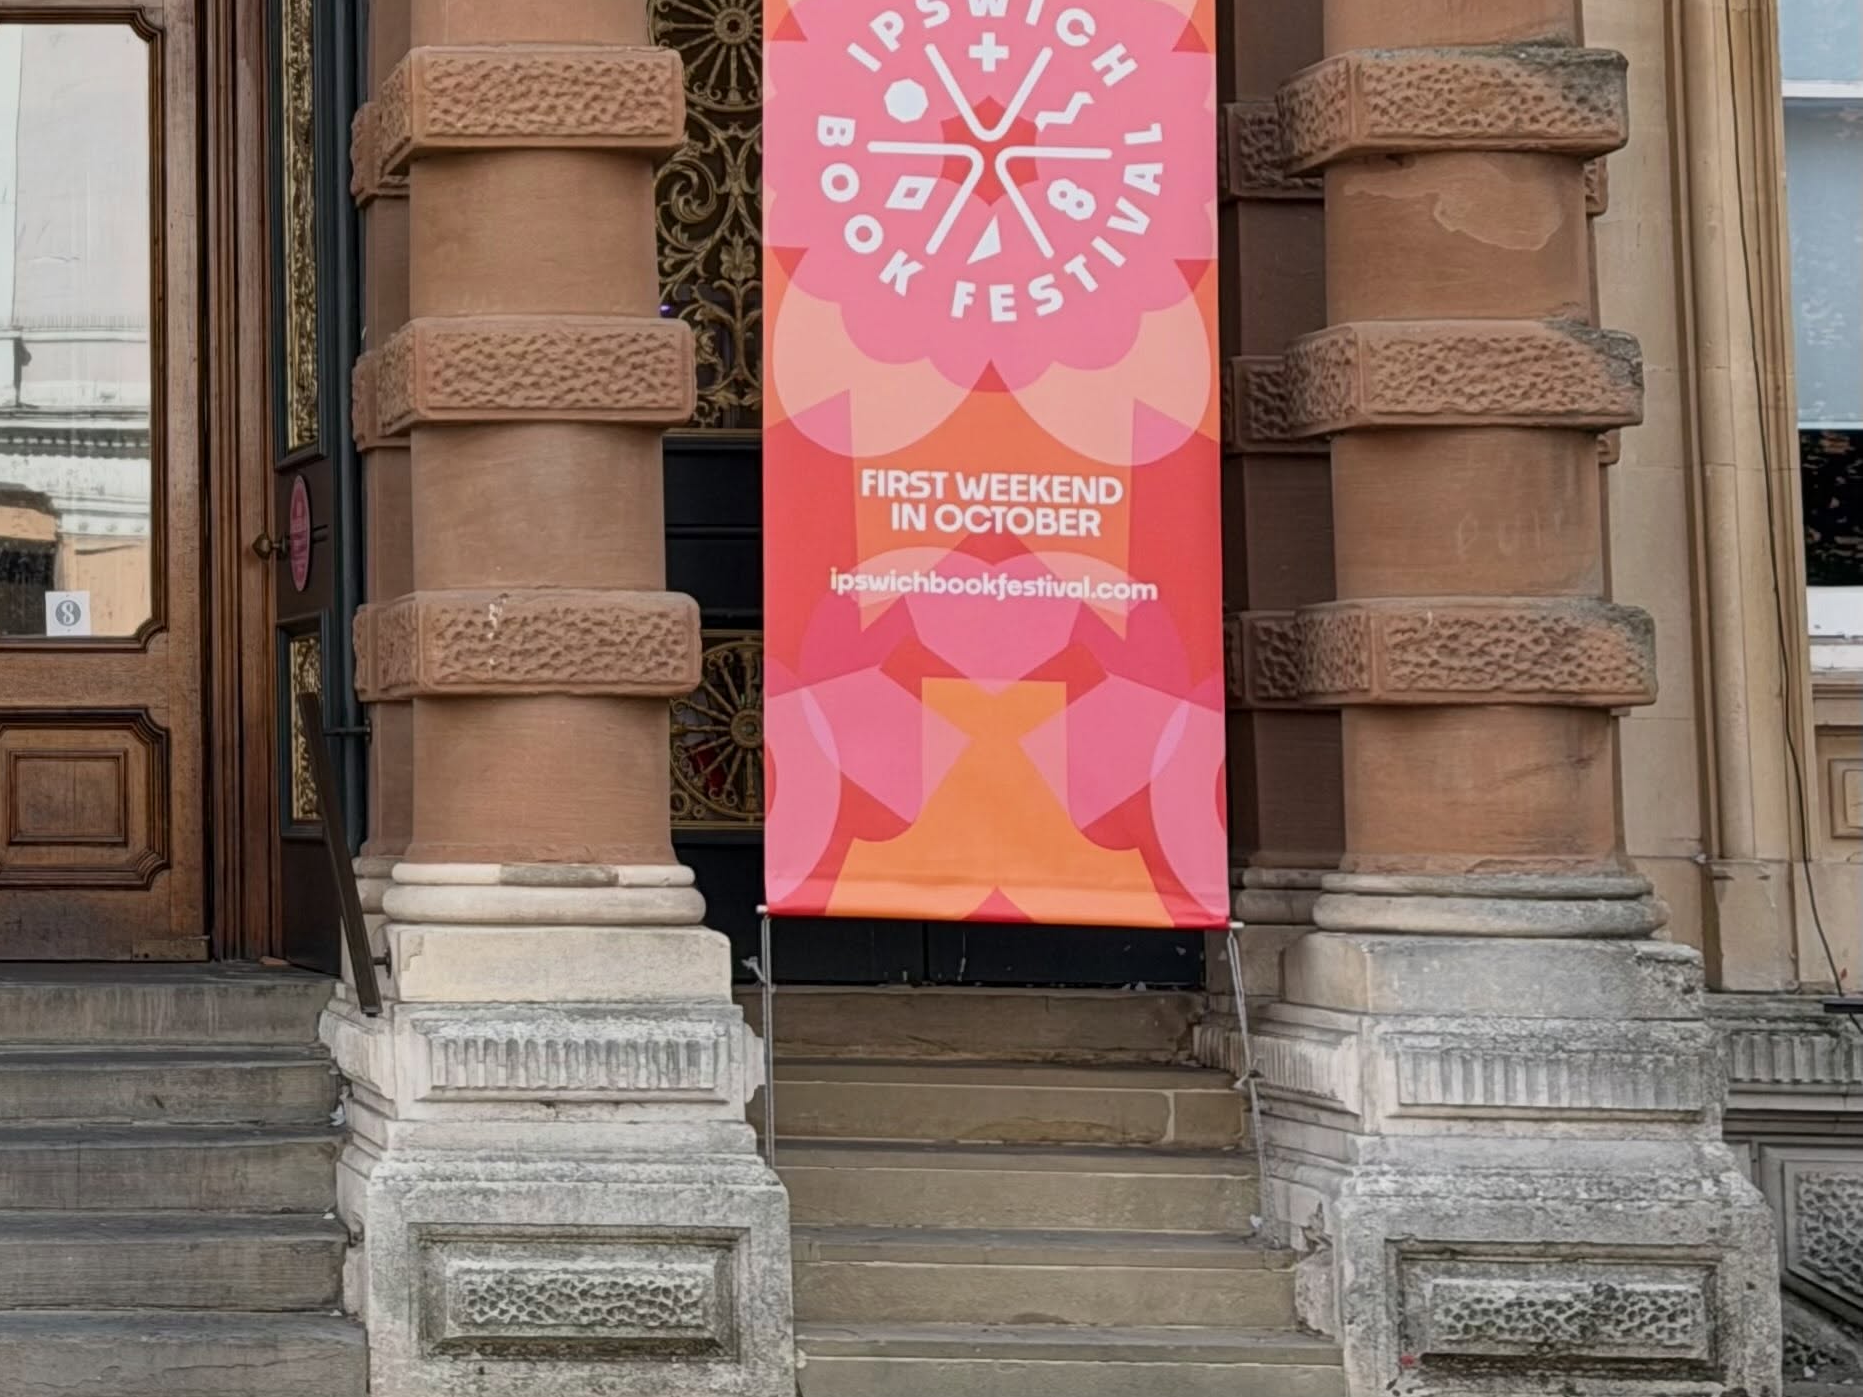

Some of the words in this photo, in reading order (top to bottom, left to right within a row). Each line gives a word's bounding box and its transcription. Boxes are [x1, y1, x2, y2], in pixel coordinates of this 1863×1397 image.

[817, 115, 924, 296] BOOK
[950, 122, 1164, 322] FESTIVAL
[861, 469, 949, 499] FIRST
[957, 472, 1124, 505] WEEKEND
[890, 502, 926, 532] IN
[934, 504, 1102, 537] OCTOBER
[830, 567, 1158, 601] ipswichbookfestival.com
